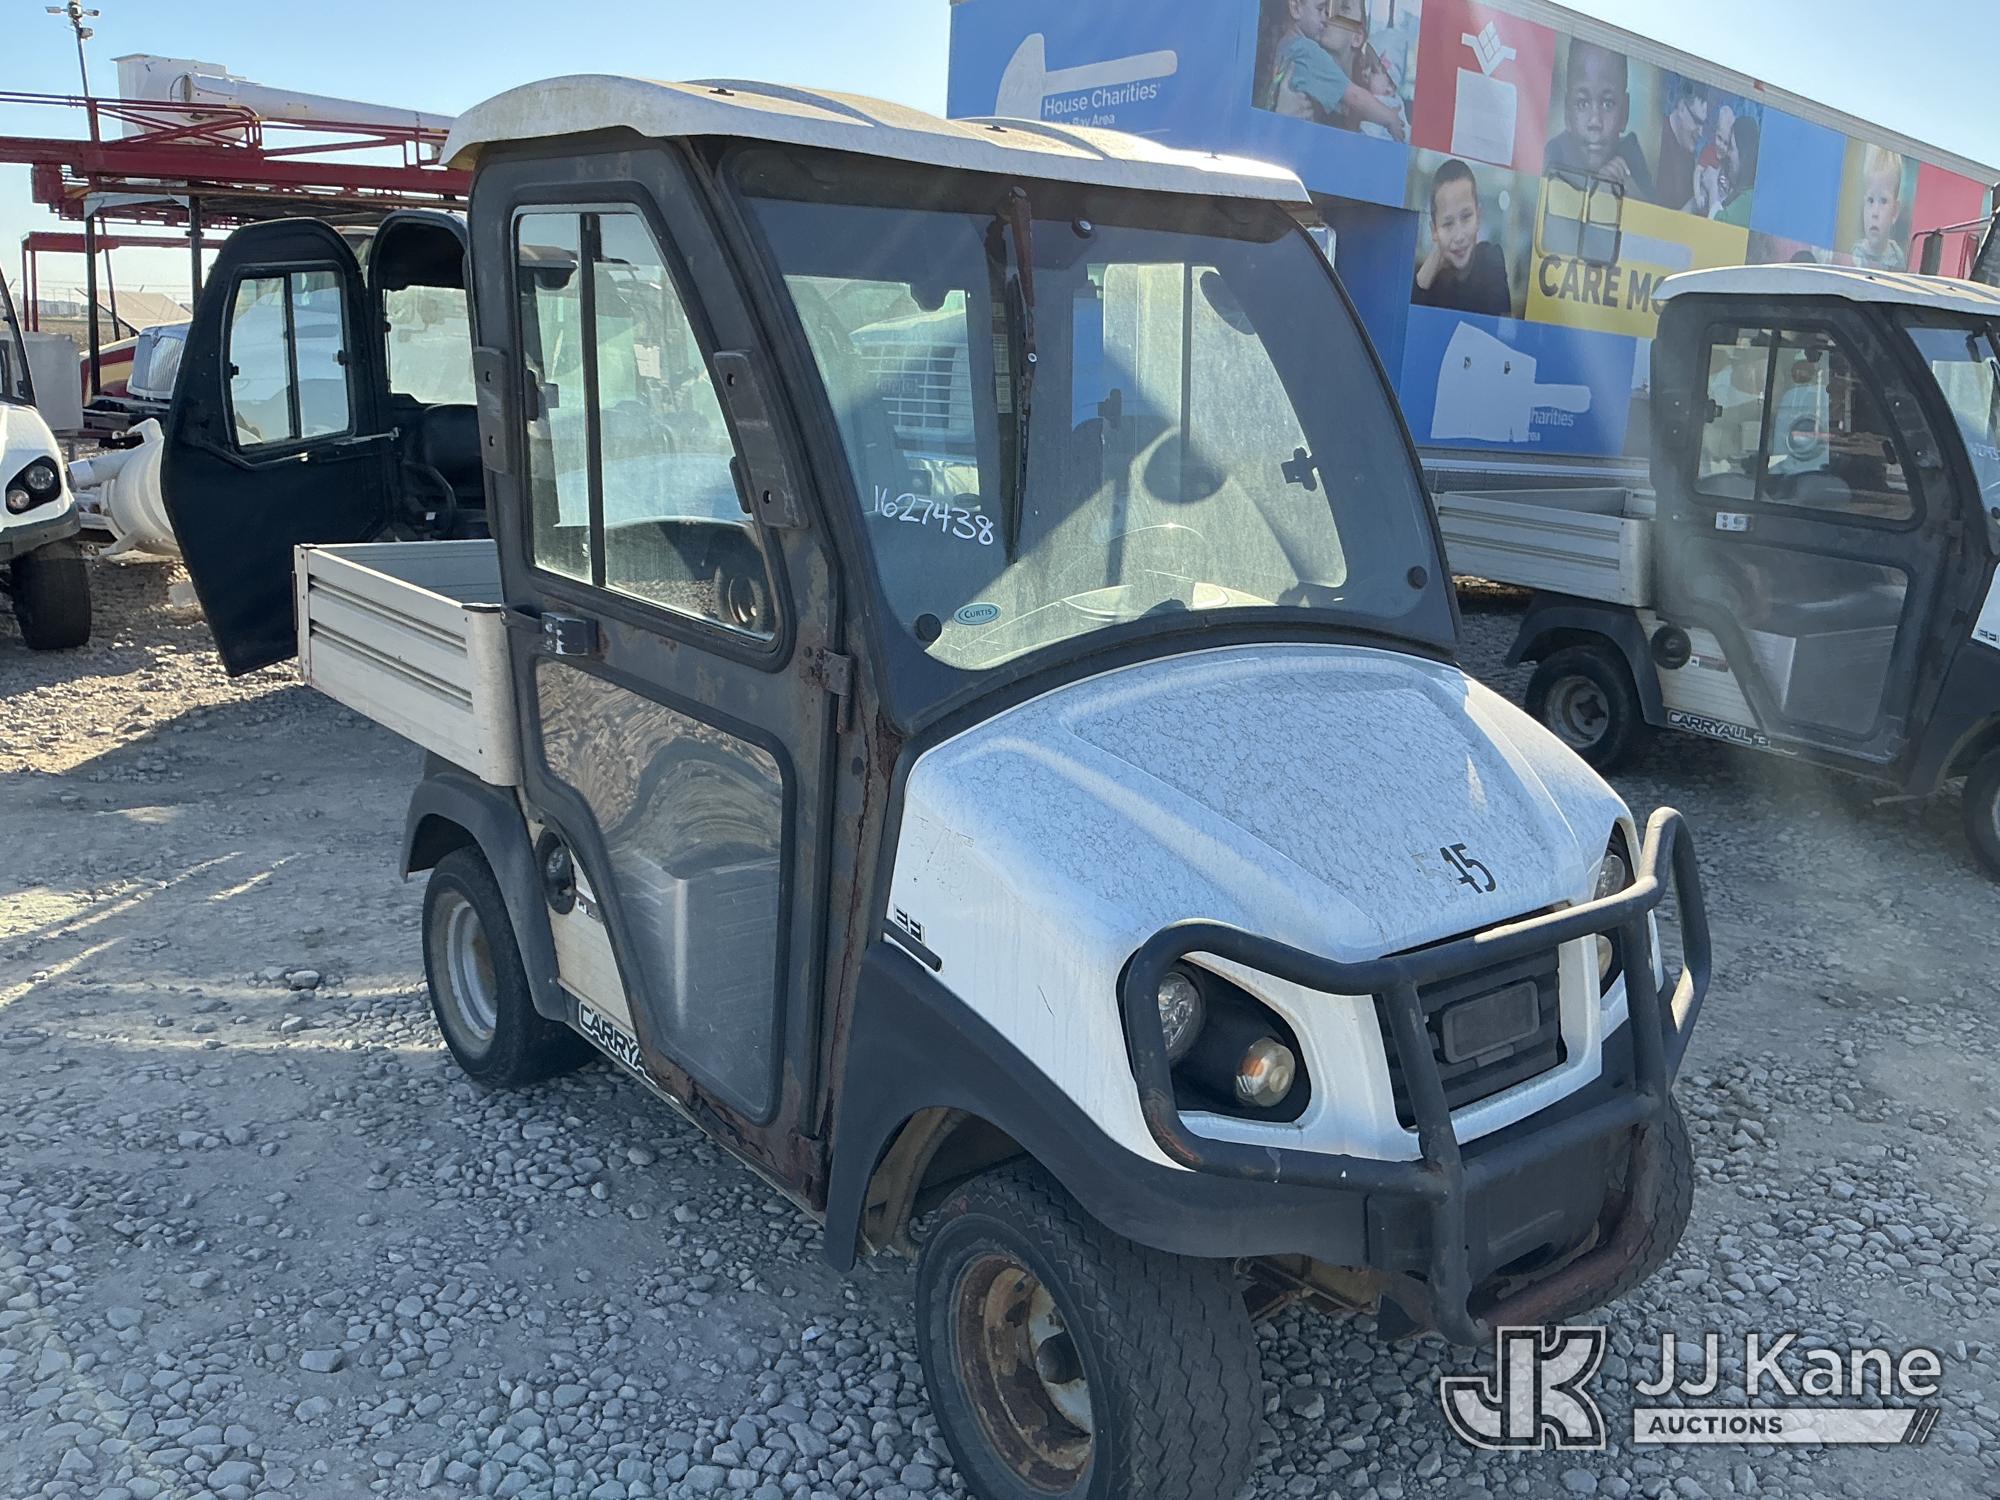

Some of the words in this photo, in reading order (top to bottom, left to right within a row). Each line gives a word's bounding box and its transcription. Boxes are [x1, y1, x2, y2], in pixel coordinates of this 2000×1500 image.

[1044, 95, 1088, 116] House
[1091, 82, 1158, 108] Charities
[1539, 254, 1621, 308] CARE
[1530, 407, 1575, 427] harities
[874, 485, 994, 545] 1627438
[1667, 709, 1753, 745] CARRYALL
